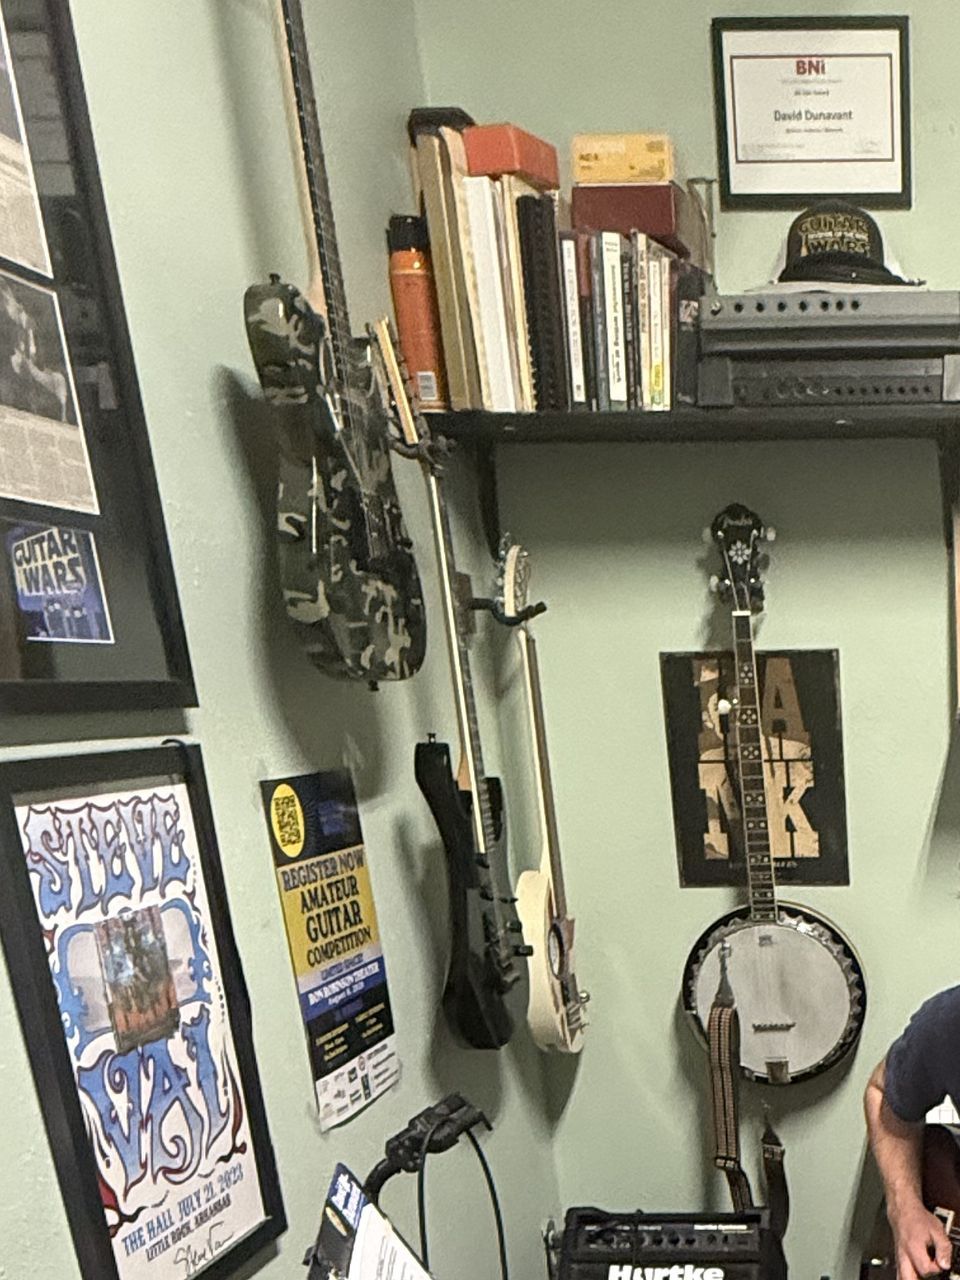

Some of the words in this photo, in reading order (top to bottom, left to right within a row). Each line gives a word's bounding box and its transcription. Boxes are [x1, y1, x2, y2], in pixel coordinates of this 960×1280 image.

[774, 110, 802, 122] David
[805, 110, 853, 121] Dunavant
[13, 529, 79, 566] GUITAR
[22, 559, 85, 594] WARS
[24, 793, 190, 919] STEVE
[281, 857, 339, 892] REGISTER
[338, 847, 365, 875] NOW
[301, 875, 359, 914] AMATEUR
[306, 900, 363, 943] GUITAR
[307, 926, 372, 967] COMPETITION
[77, 1004, 232, 1201] VAI
[121, 1227, 147, 1257] THE
[147, 1213, 175, 1242] HALL
[177, 1193, 201, 1225] JULY
[145, 1236, 170, 1262] LITTLE
[194, 1195, 232, 1235] ARKANSAS
